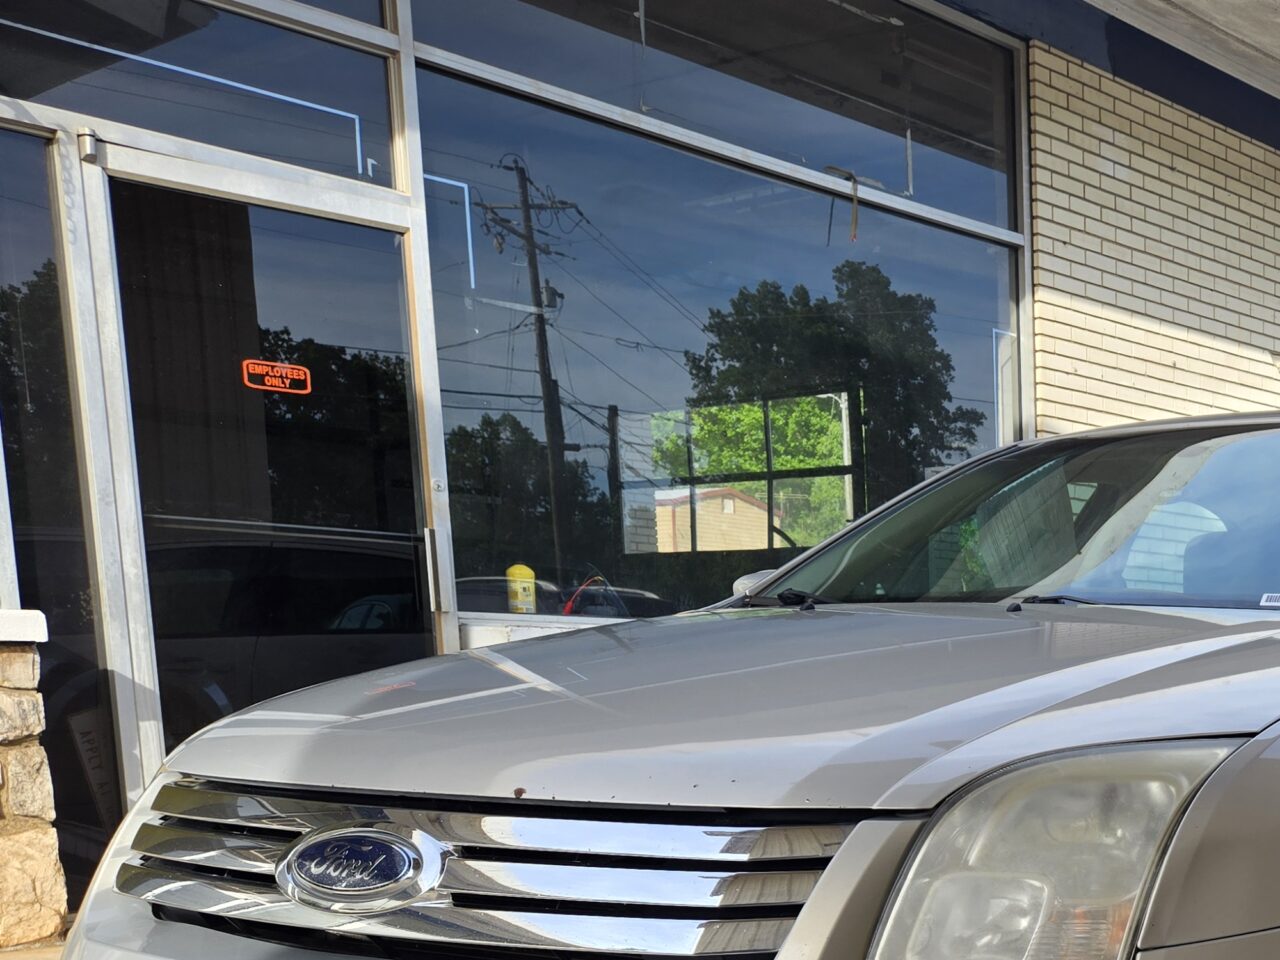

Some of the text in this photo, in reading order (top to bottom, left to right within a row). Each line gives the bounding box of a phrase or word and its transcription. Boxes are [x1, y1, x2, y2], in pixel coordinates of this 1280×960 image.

[248, 363, 306, 380] EMPLOYEES
[264, 376, 291, 388] ONLY
[310, 841, 386, 881] Ford
